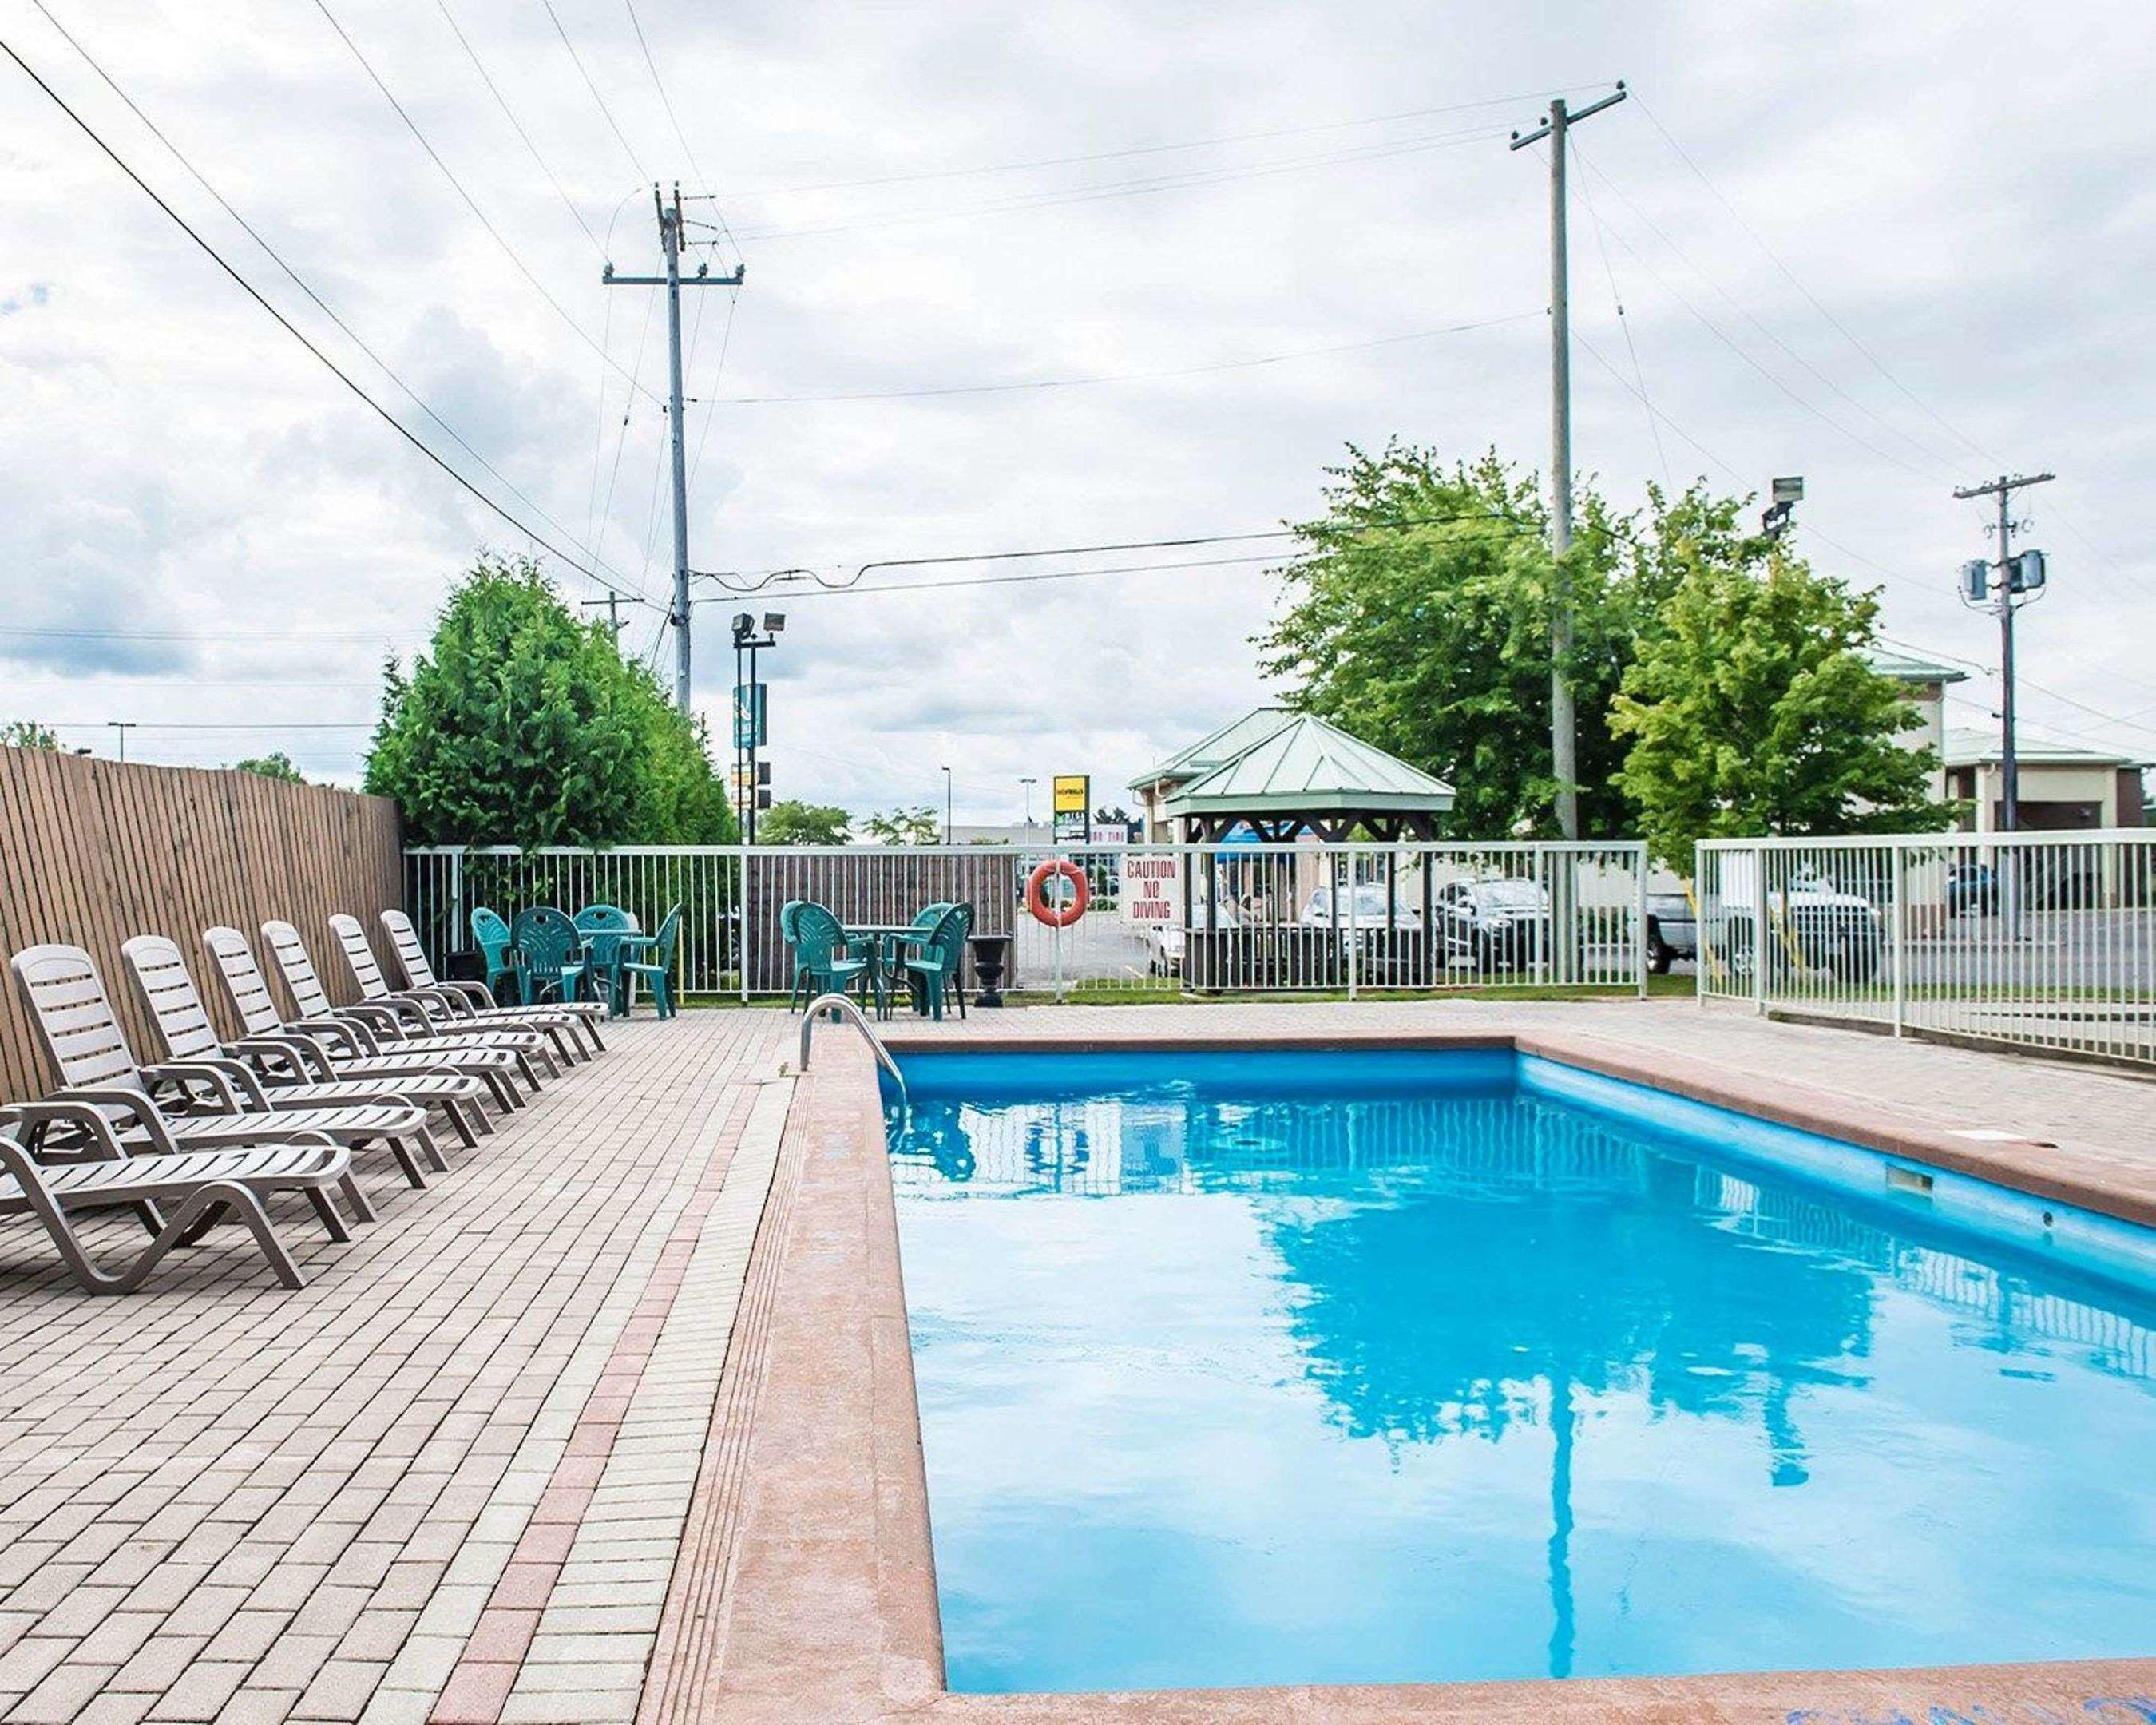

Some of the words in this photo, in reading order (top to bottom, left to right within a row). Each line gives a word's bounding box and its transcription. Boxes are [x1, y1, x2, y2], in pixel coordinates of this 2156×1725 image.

[1127, 860, 1175, 879] CAUTION
[1143, 880, 1160, 898] NO
[1132, 900, 1171, 919] DIVING
